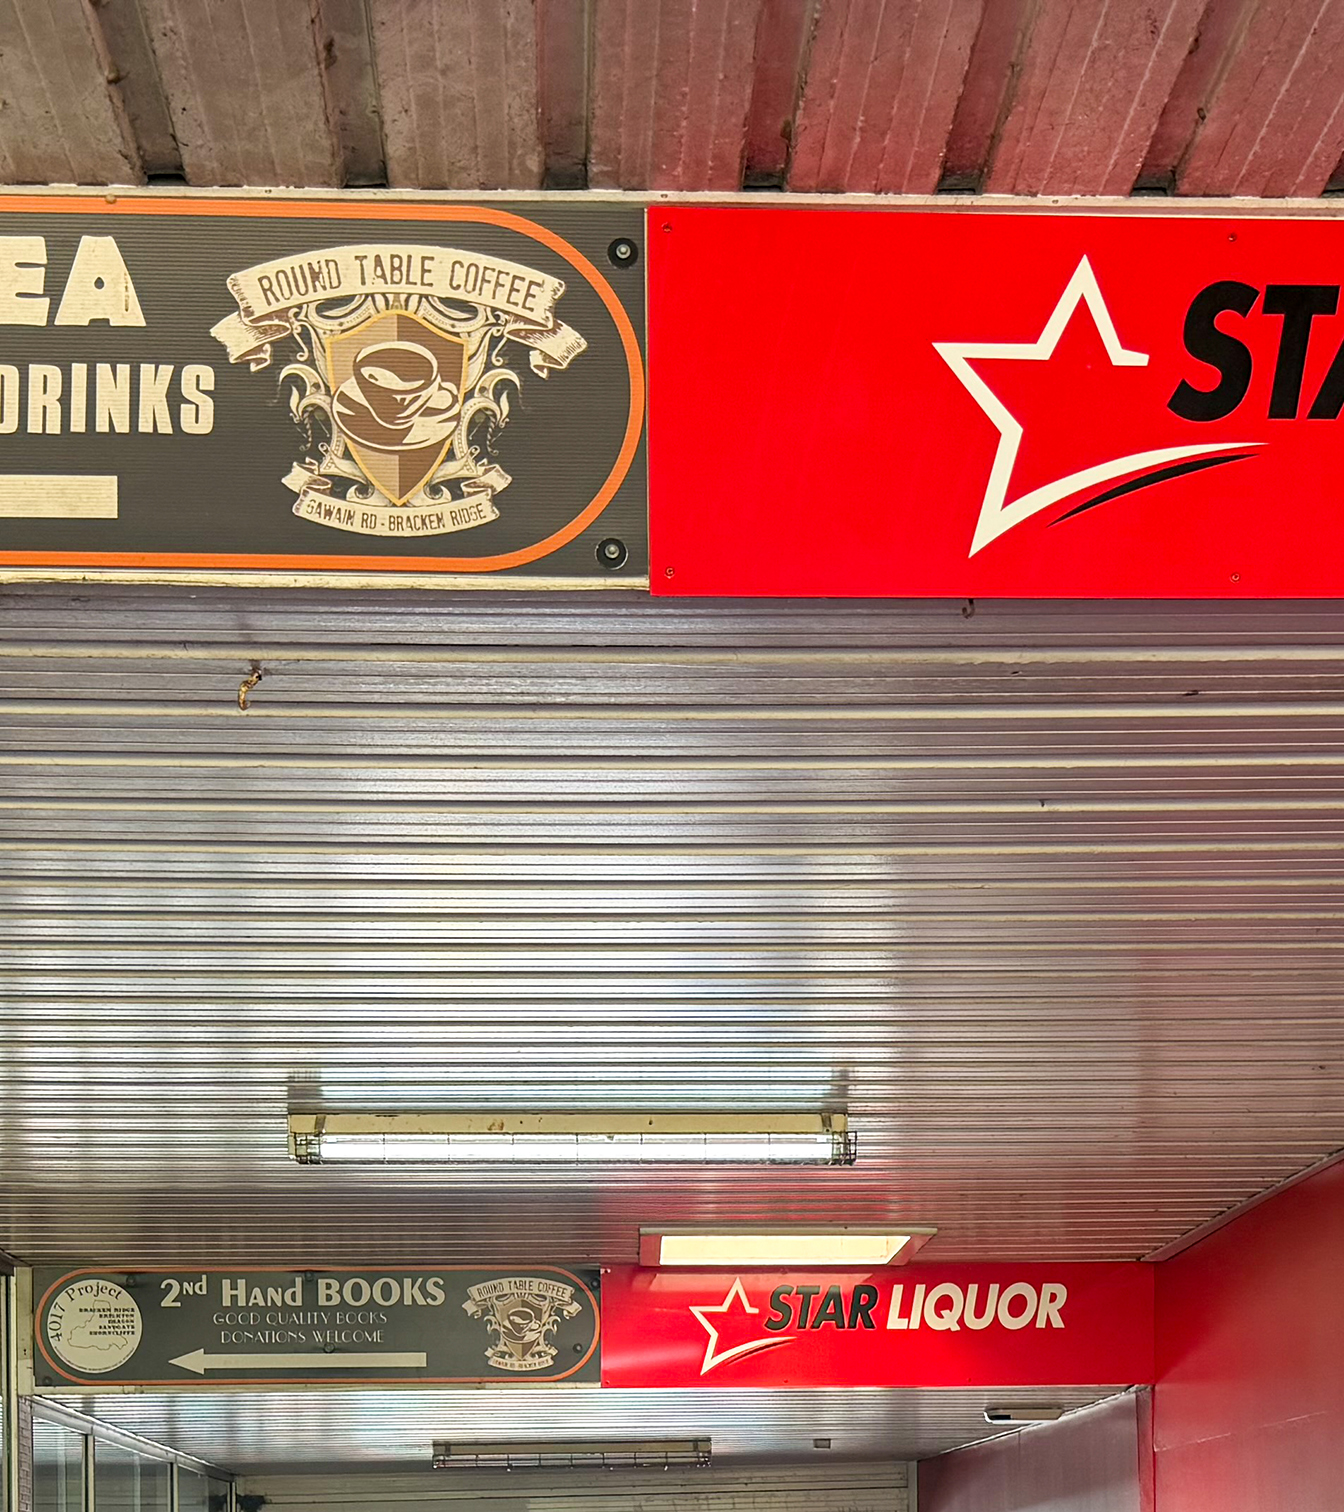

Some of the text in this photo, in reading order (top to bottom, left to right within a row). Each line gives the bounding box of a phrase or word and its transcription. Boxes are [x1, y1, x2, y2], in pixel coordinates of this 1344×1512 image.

[257, 254, 540, 314] ROUND TABLE COFFEE
[306, 500, 355, 527] GAWAIN
[361, 513, 377, 530] RD
[388, 510, 445, 532] BRACKEN
[450, 502, 487, 526] RIDGE
[160, 1274, 207, 1307] 2nd
[317, 1276, 446, 1307] BOOKS
[477, 1280, 567, 1298] ROUND TABLE COFFEE
[48, 1282, 122, 1342] 4017 Project
[213, 1311, 387, 1327] GOOD QUALITY BOOKS
[764, 1281, 1068, 1332] STAR LIQUOR
[221, 1330, 385, 1344] DONATIONS WELCOME
